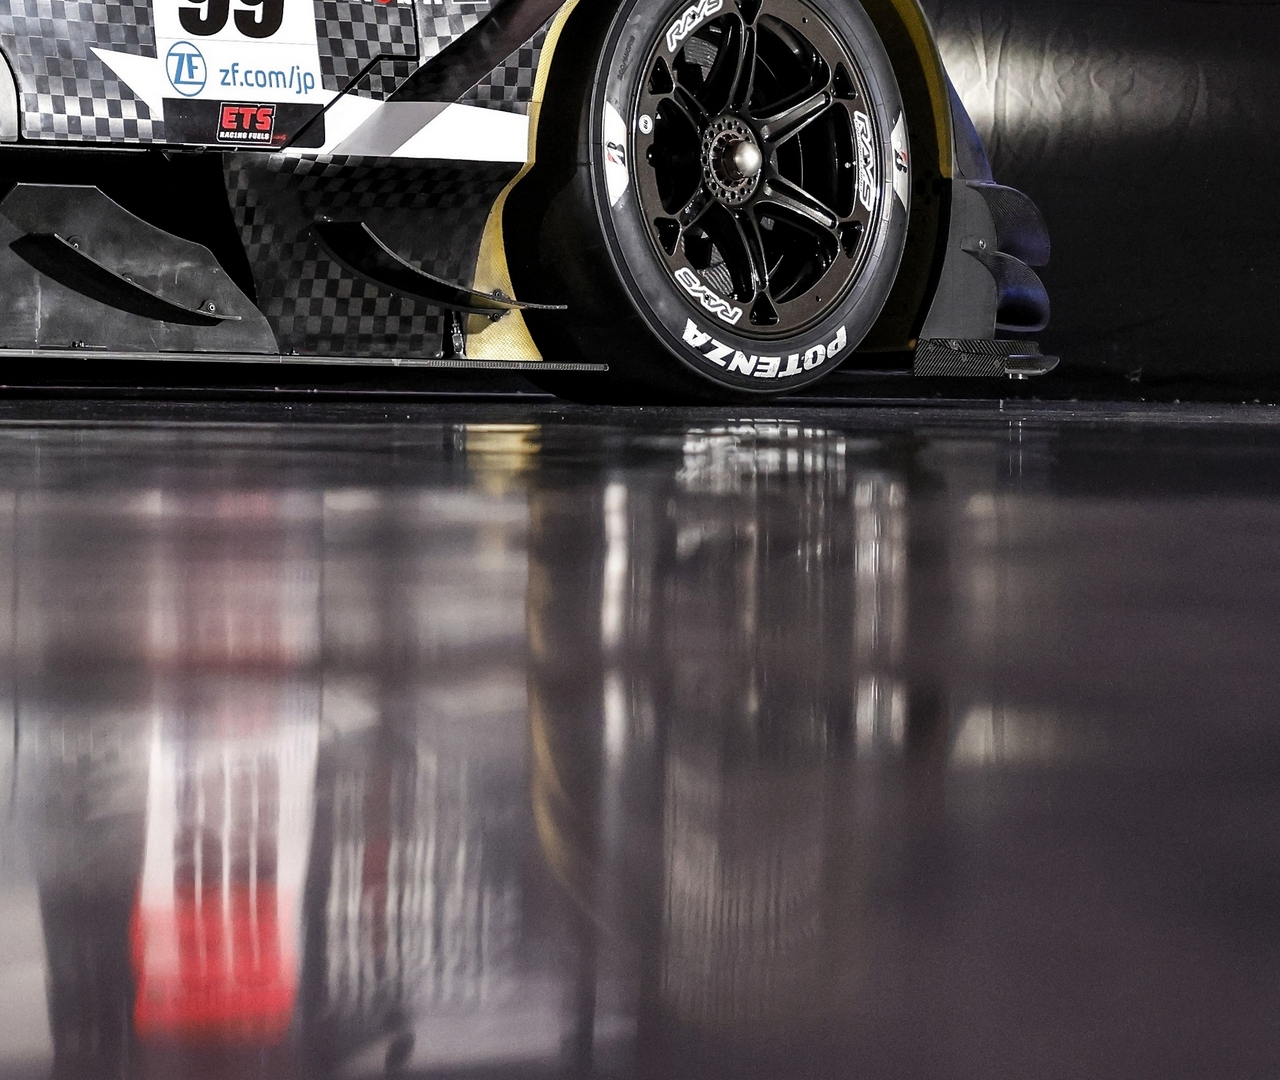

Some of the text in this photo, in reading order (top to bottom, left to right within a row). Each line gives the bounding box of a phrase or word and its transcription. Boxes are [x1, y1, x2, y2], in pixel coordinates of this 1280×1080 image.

[167, 52, 204, 86] ZF
[219, 62, 316, 95] zf.com/jp
[219, 131, 247, 139] RACING
[248, 132, 270, 140] FUELS
[222, 106, 273, 131] ETS
[854, 110, 874, 212] RAYS
[674, 267, 743, 325] RAYS
[682, 317, 847, 378] POTENZA
